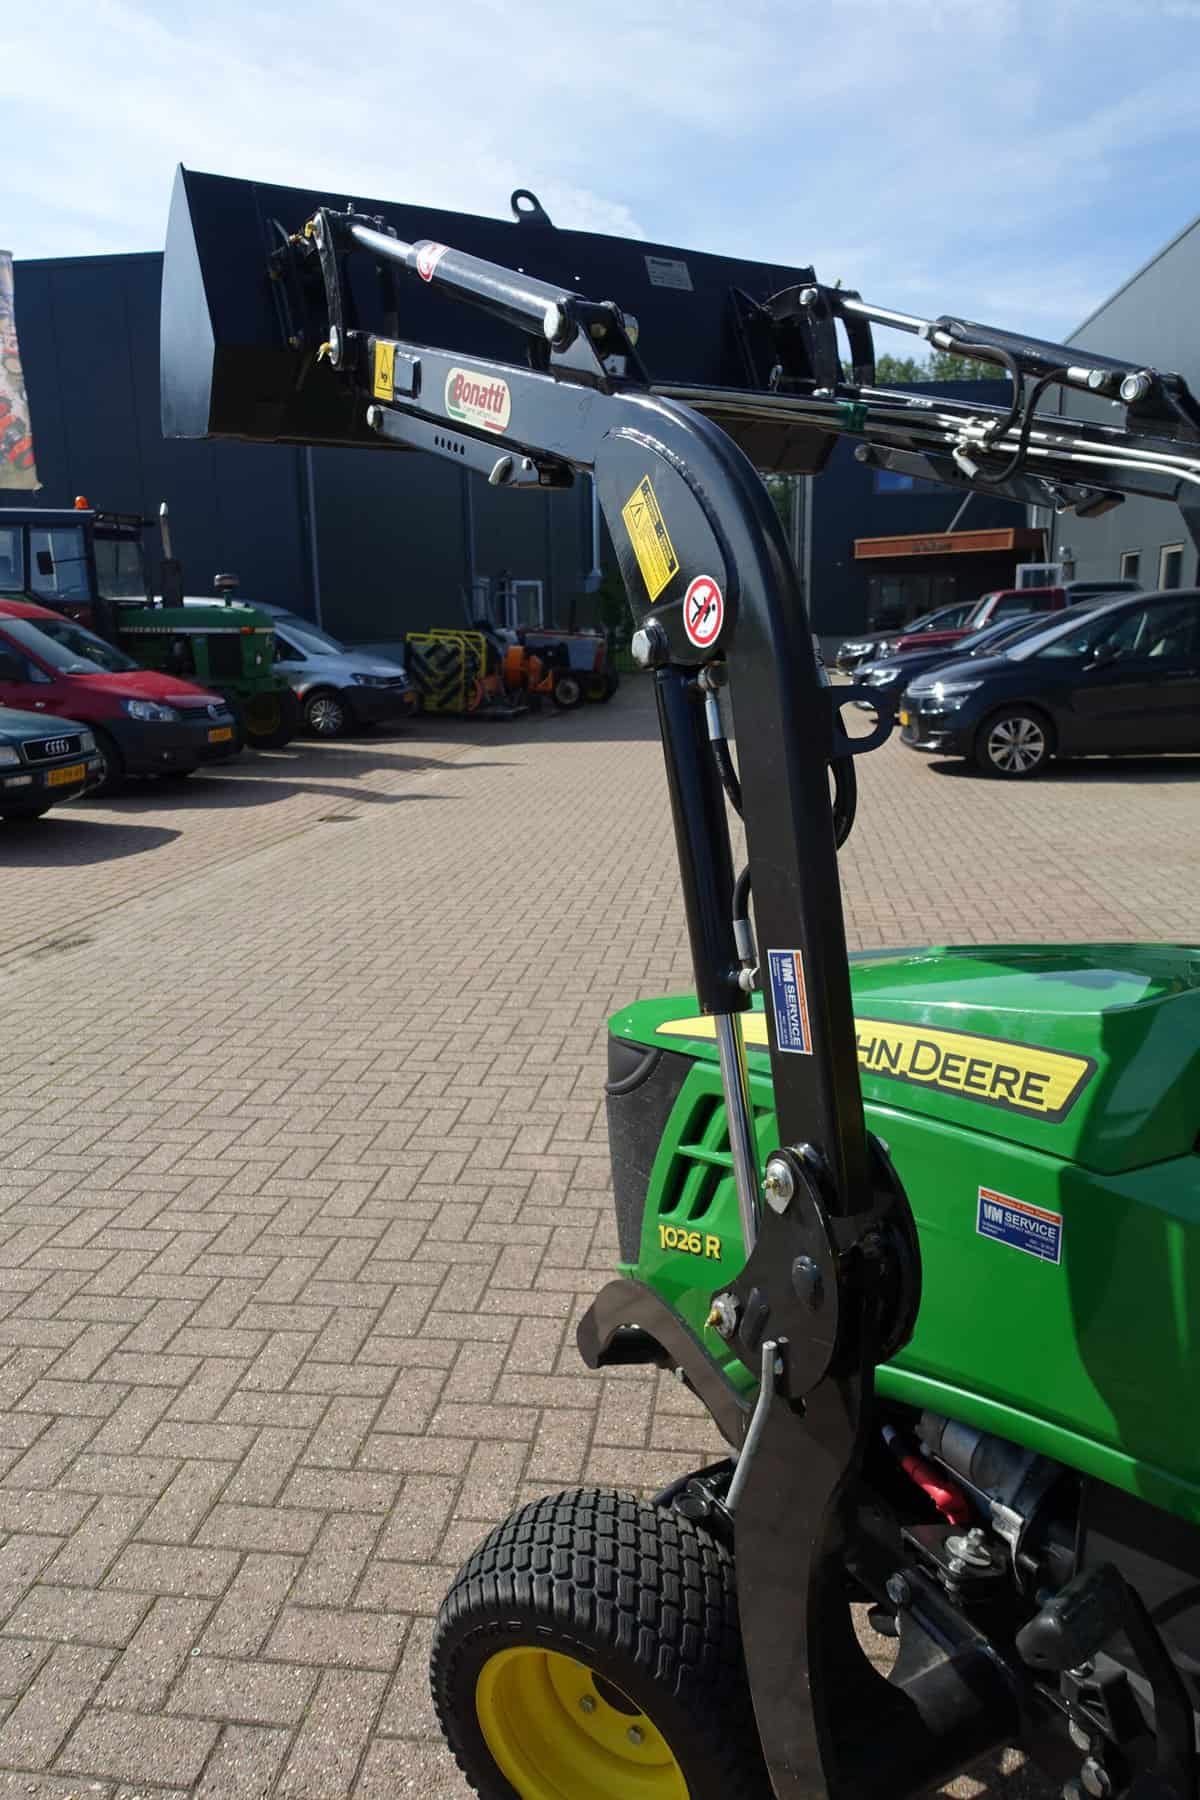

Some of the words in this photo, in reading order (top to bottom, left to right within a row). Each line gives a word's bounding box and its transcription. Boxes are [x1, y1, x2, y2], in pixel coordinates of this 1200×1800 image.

[453, 373, 506, 414] Bonatti
[787, 984, 801, 1046] SERVICE
[856, 1034, 902, 1075] HN
[908, 1039, 1051, 1106] DEERE
[658, 1224, 702, 1254] 1026
[706, 1234, 721, 1259] R
[1004, 1211, 1057, 1240] SERVICE
